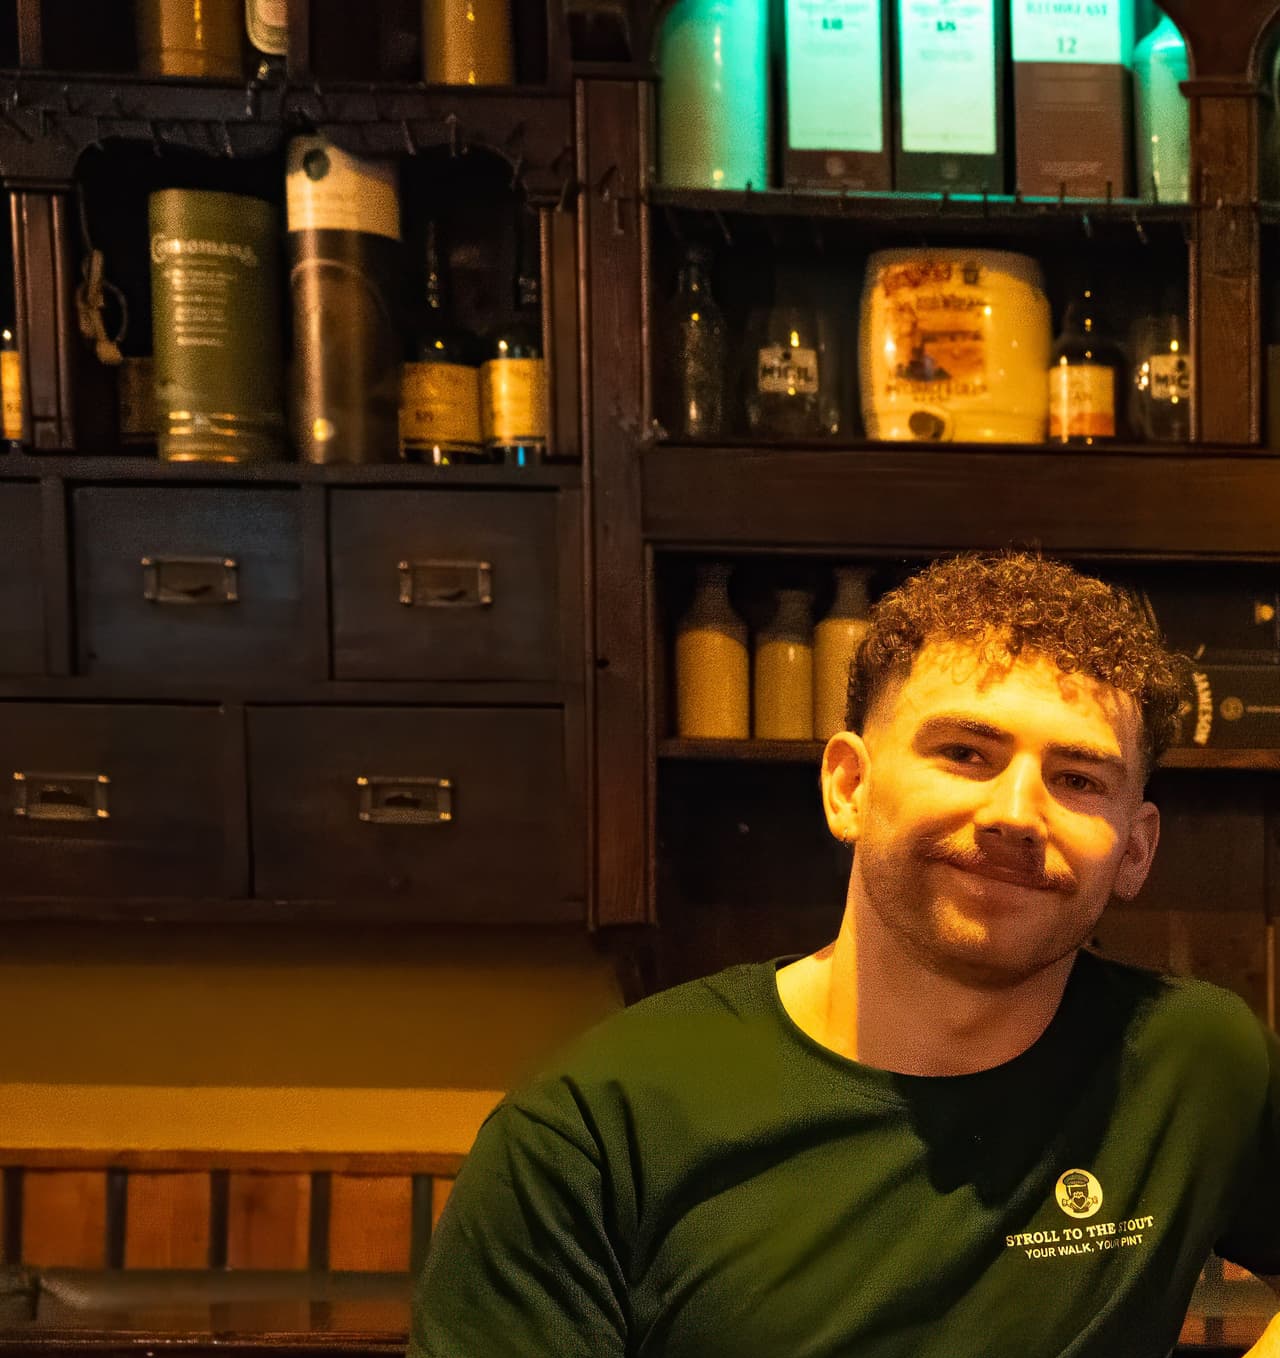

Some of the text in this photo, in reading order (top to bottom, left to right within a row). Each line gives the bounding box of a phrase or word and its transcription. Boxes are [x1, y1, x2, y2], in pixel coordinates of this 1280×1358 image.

[1006, 1215, 1154, 1247] STROLL TO THE STOUT
[1025, 1234, 1144, 1260] YOUR WALK, YOUR PINT
